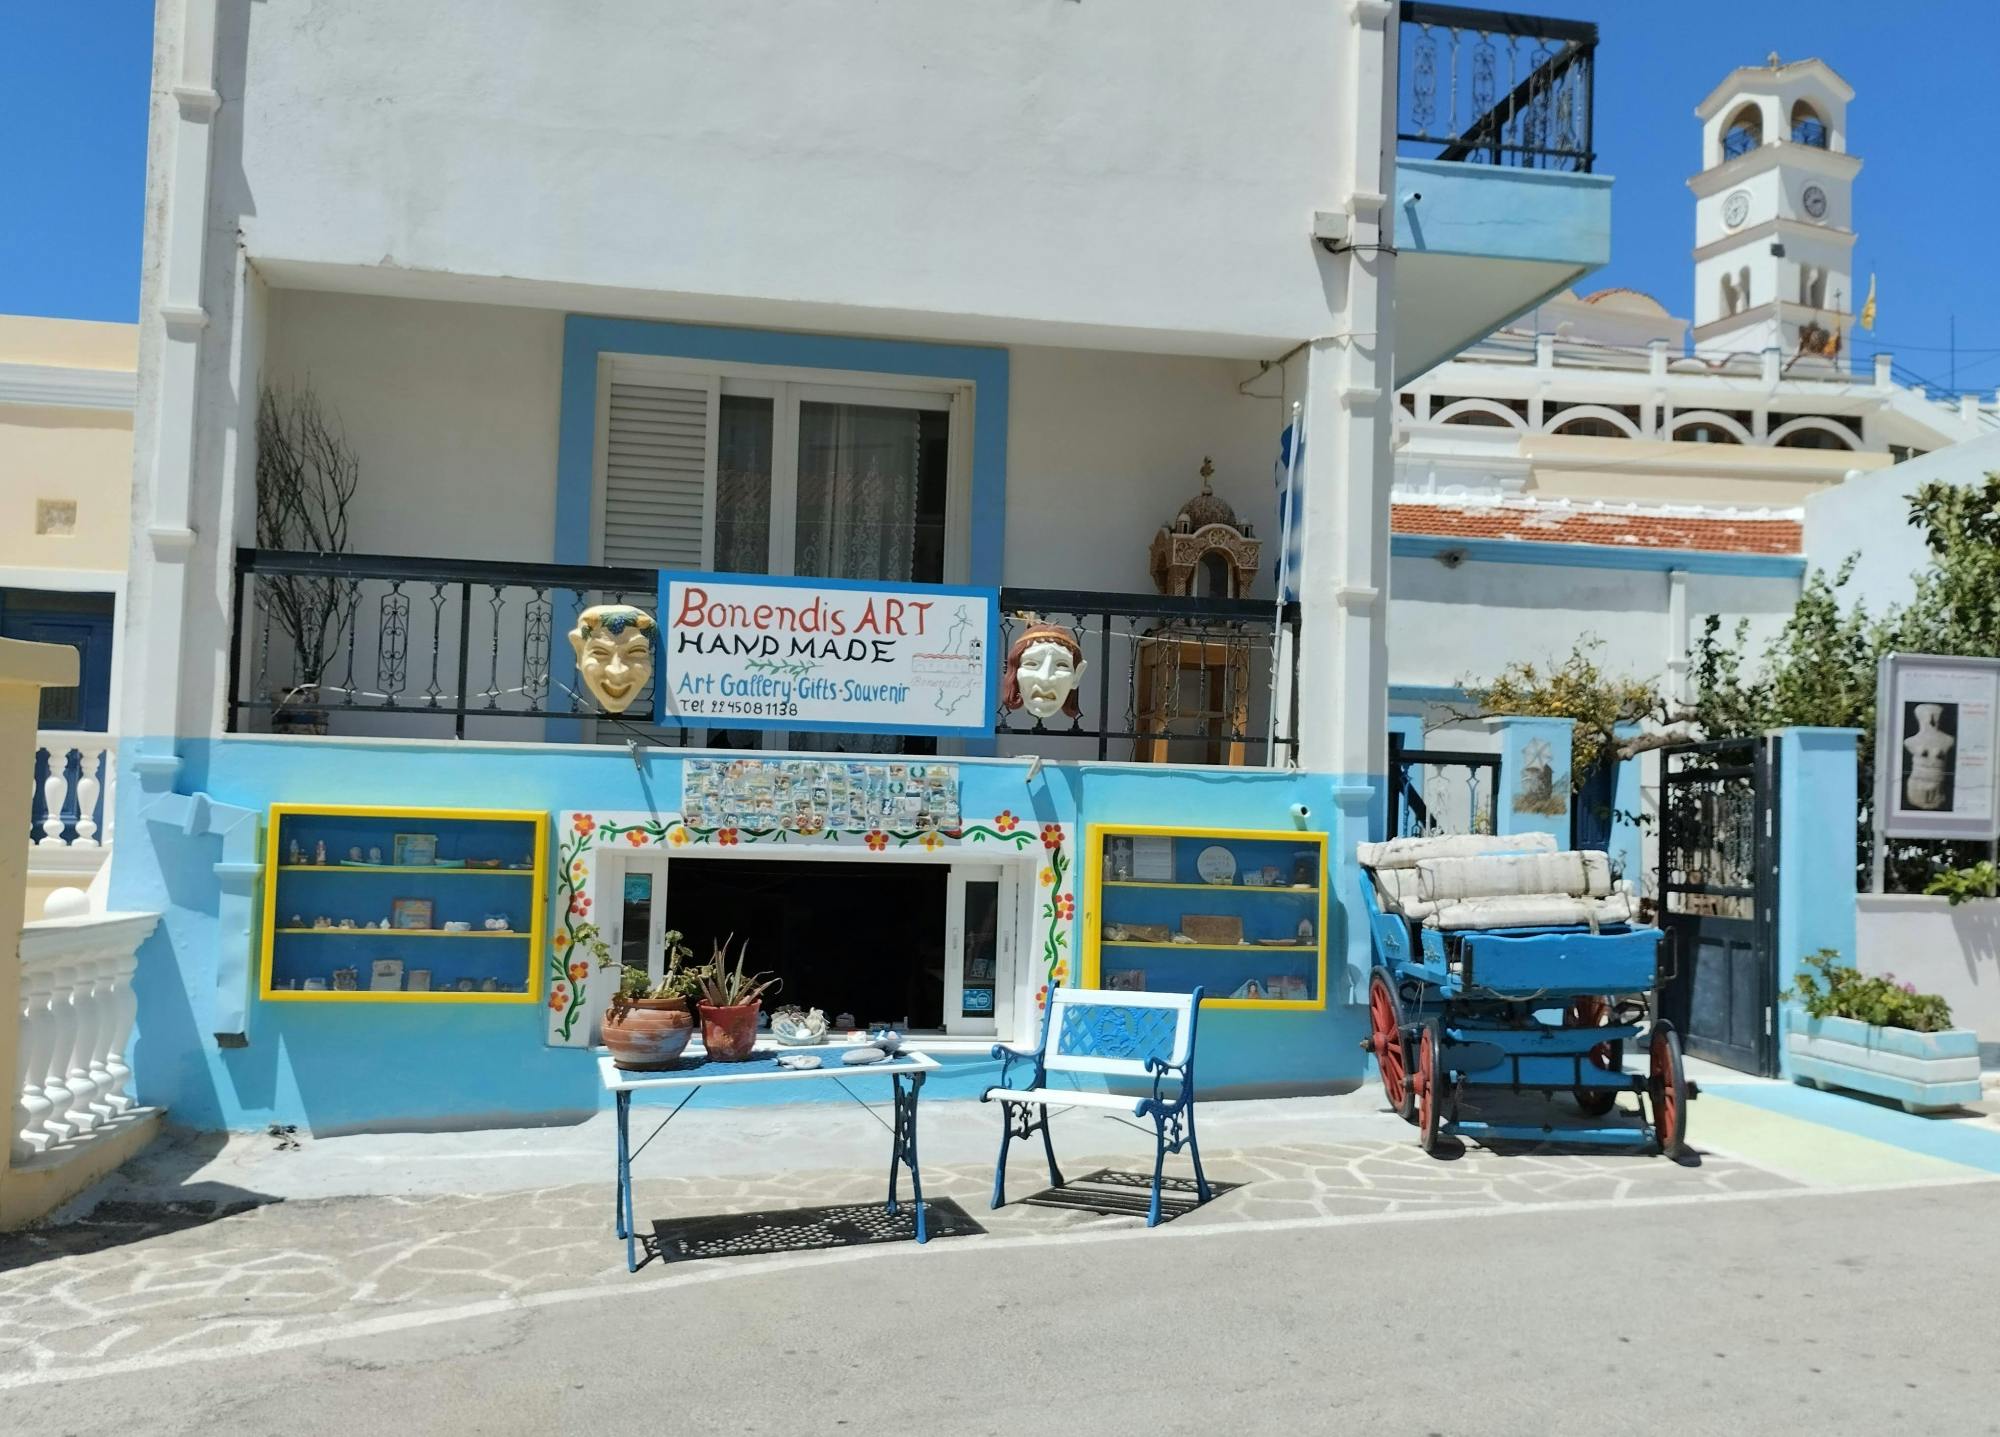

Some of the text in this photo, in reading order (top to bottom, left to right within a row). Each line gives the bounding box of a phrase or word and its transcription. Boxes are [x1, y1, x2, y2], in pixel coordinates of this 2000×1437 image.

[674, 587, 934, 636] Bonendis ART
[677, 671, 715, 695] Art
[679, 699, 705, 713] Tel
